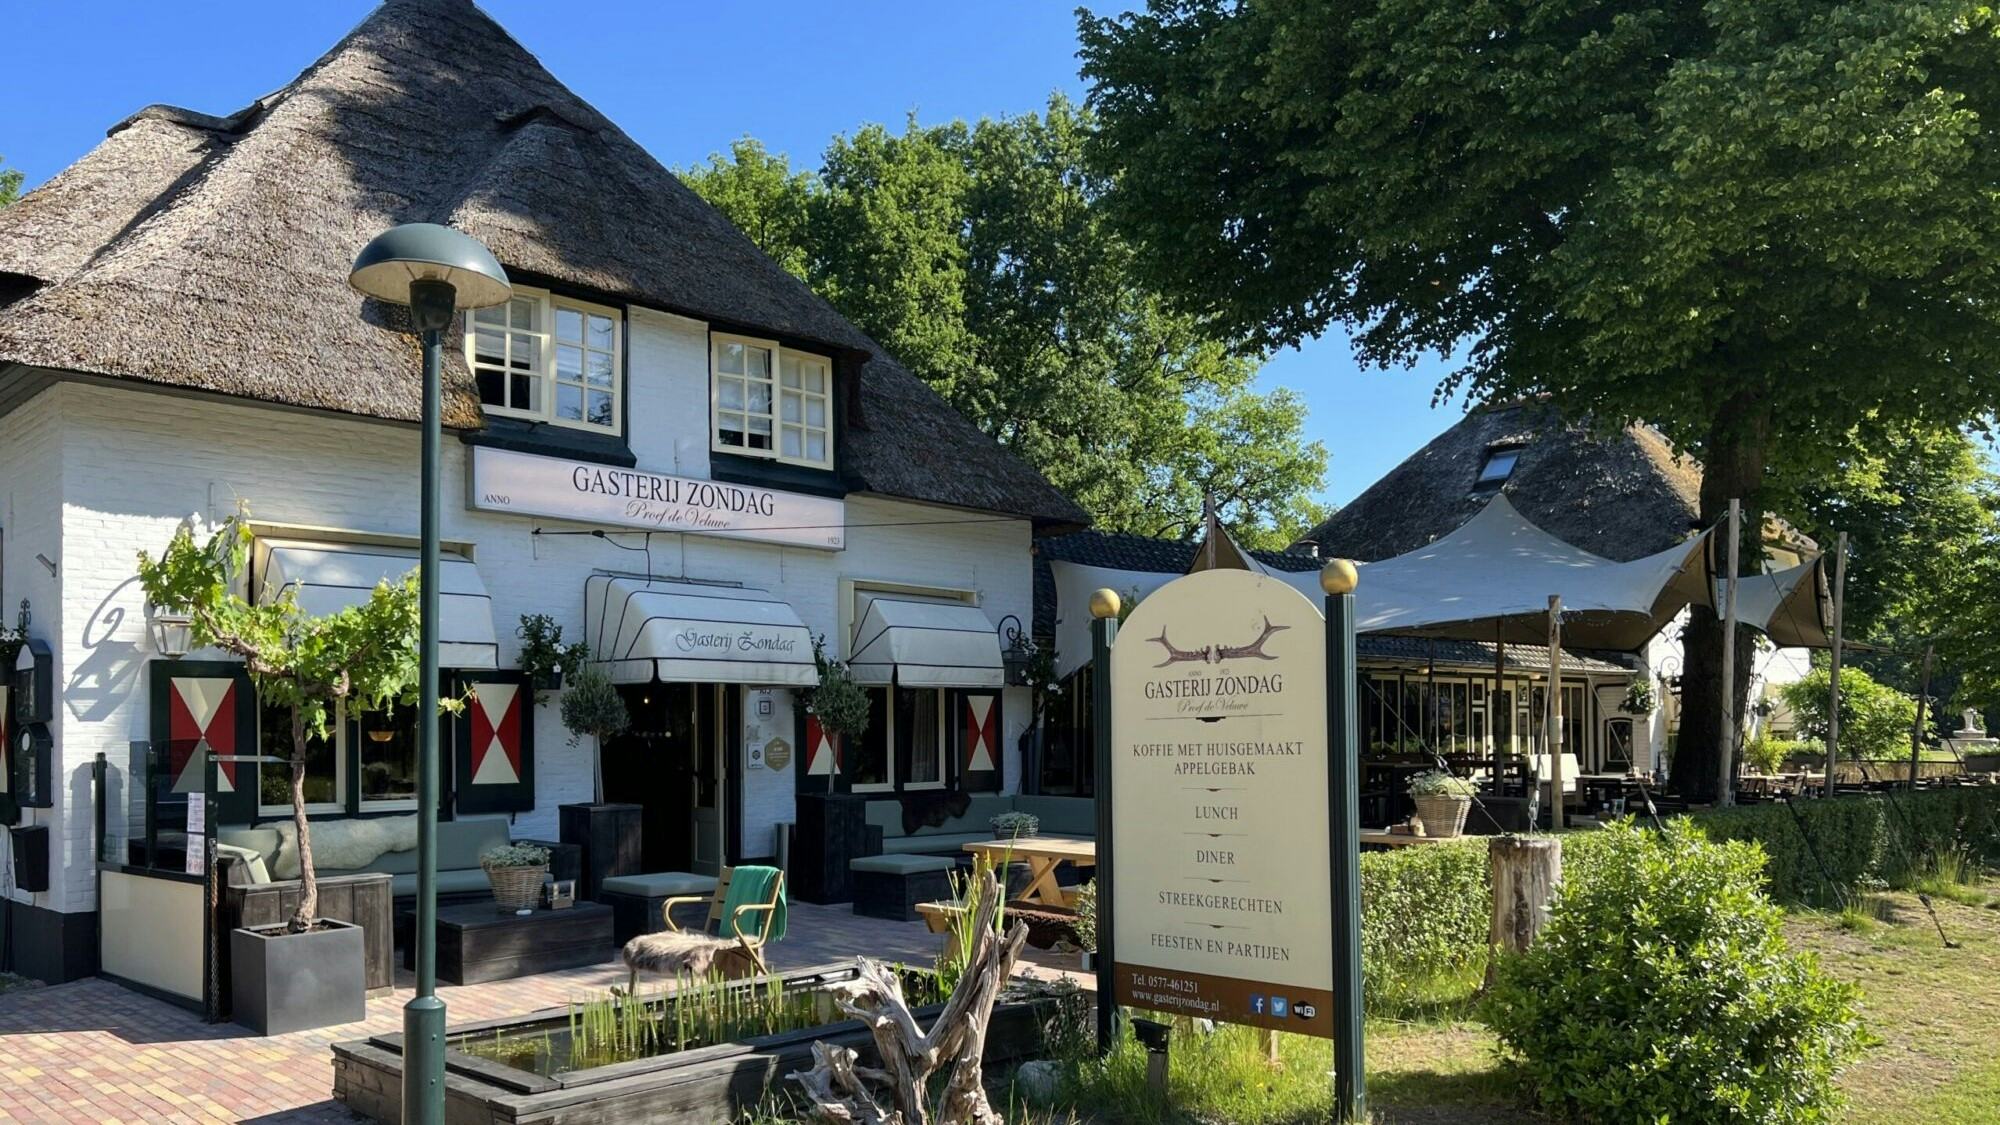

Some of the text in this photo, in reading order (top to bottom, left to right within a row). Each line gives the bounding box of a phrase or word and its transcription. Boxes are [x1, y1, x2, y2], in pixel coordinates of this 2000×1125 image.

[484, 494, 511, 505] ANNO
[573, 466, 774, 517] GASTERIJ ZONDAG
[625, 500, 731, 528] Proef de Veluwe
[675, 627, 732, 654] Gasterij
[1144, 674, 1283, 700] GASTERIJ ZONDAG
[1133, 742, 1304, 757] KOFFIE MET HUISGEMAAKT
[1174, 762, 1256, 775] APPELGEBAK
[1195, 806, 1239, 820] LUNCH
[1196, 850, 1235, 865] DINER
[1159, 891, 1283, 914] STREEKGERECHTEN
[1151, 933, 1290, 961] FEESTEN EN PARTIJEN
[1132, 973, 1198, 994] Tel. 0577-461251
[1132, 990, 1220, 1013] www.gasterijzondag.nl
